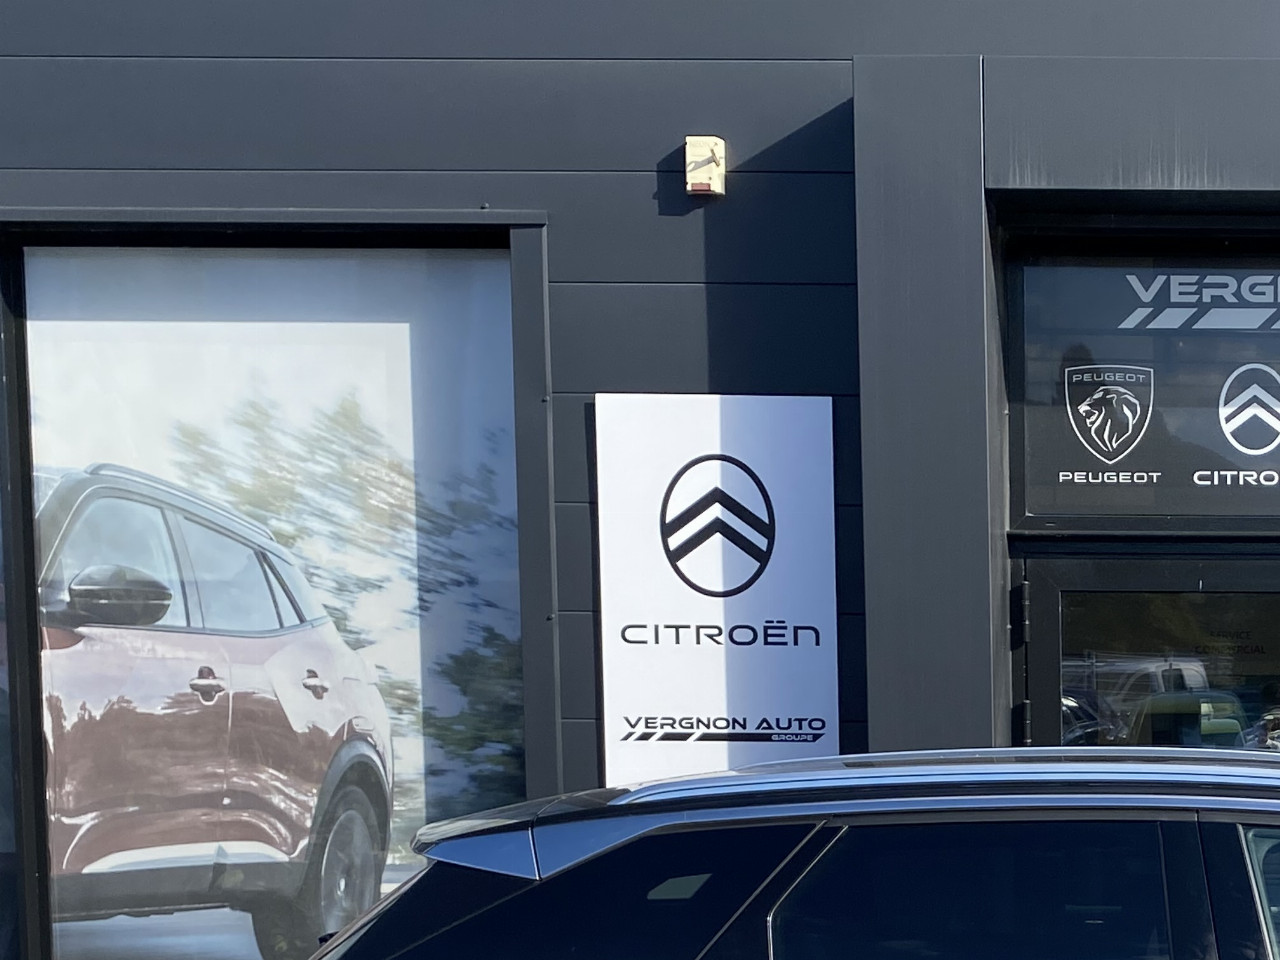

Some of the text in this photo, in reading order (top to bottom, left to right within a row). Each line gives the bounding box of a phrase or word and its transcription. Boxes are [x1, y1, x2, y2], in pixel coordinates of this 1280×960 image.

[1072, 371, 1146, 384] PEUGEOT
[1058, 471, 1162, 484] PEUGEOT
[623, 716, 827, 731] VERGNON AUTO
[771, 734, 814, 742] GROUPE
